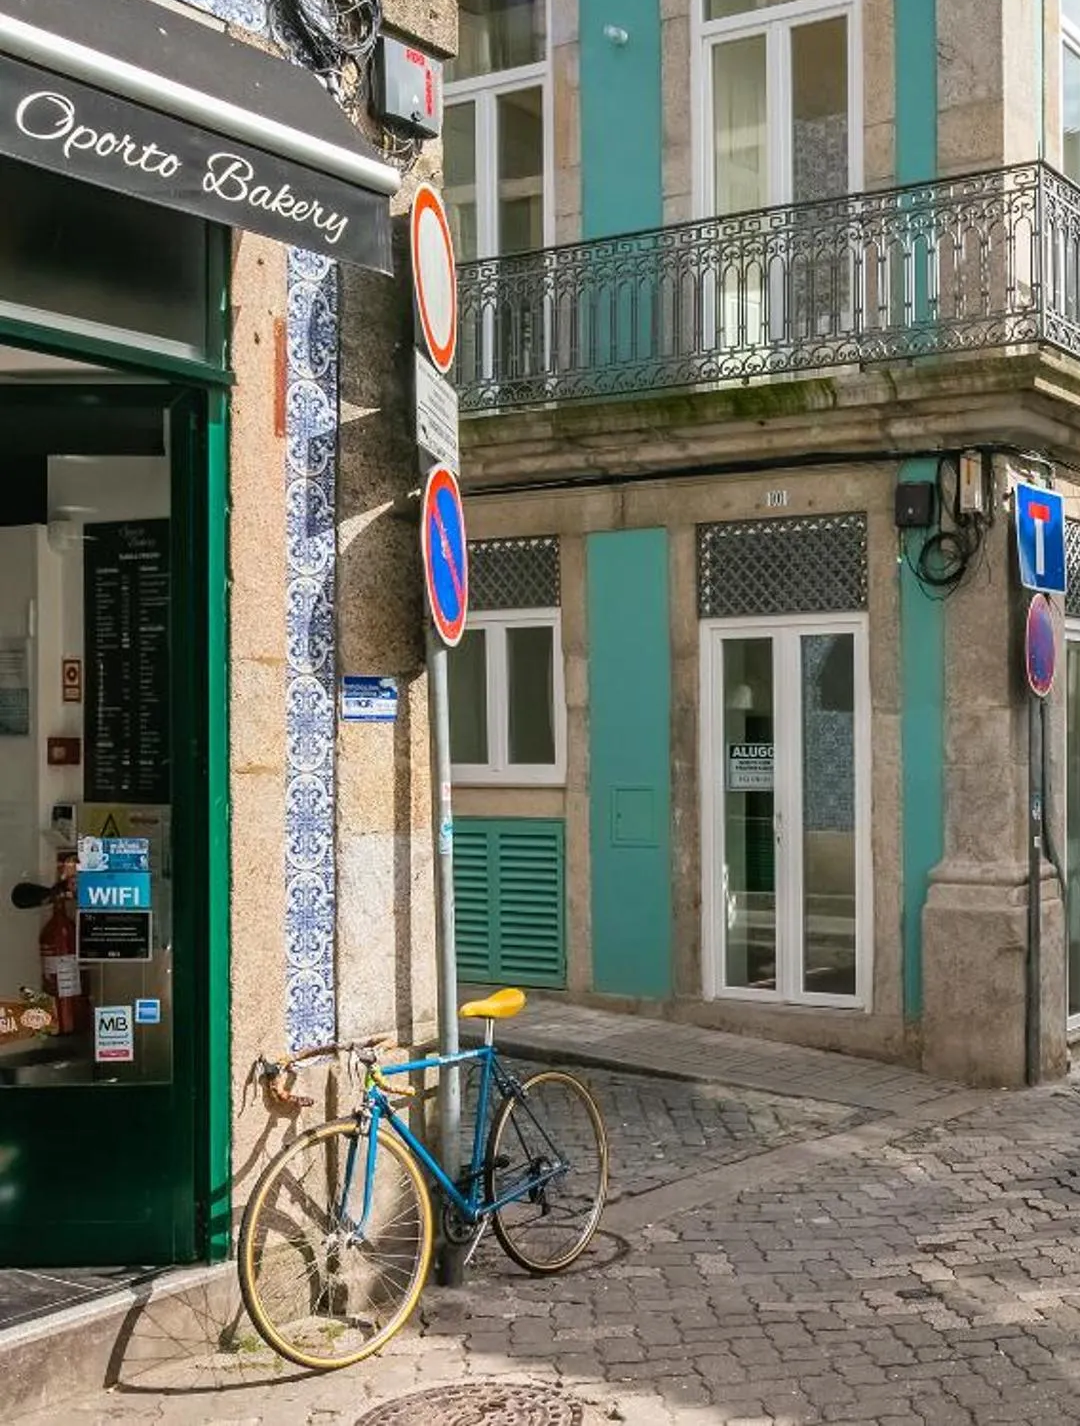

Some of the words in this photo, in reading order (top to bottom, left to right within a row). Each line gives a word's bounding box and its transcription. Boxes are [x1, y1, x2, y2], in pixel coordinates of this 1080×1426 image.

[16, 91, 182, 178] Oporto
[202, 152, 349, 244] Bakery
[87, 886, 140, 905] WIFI
[99, 1017, 128, 1031] MB
